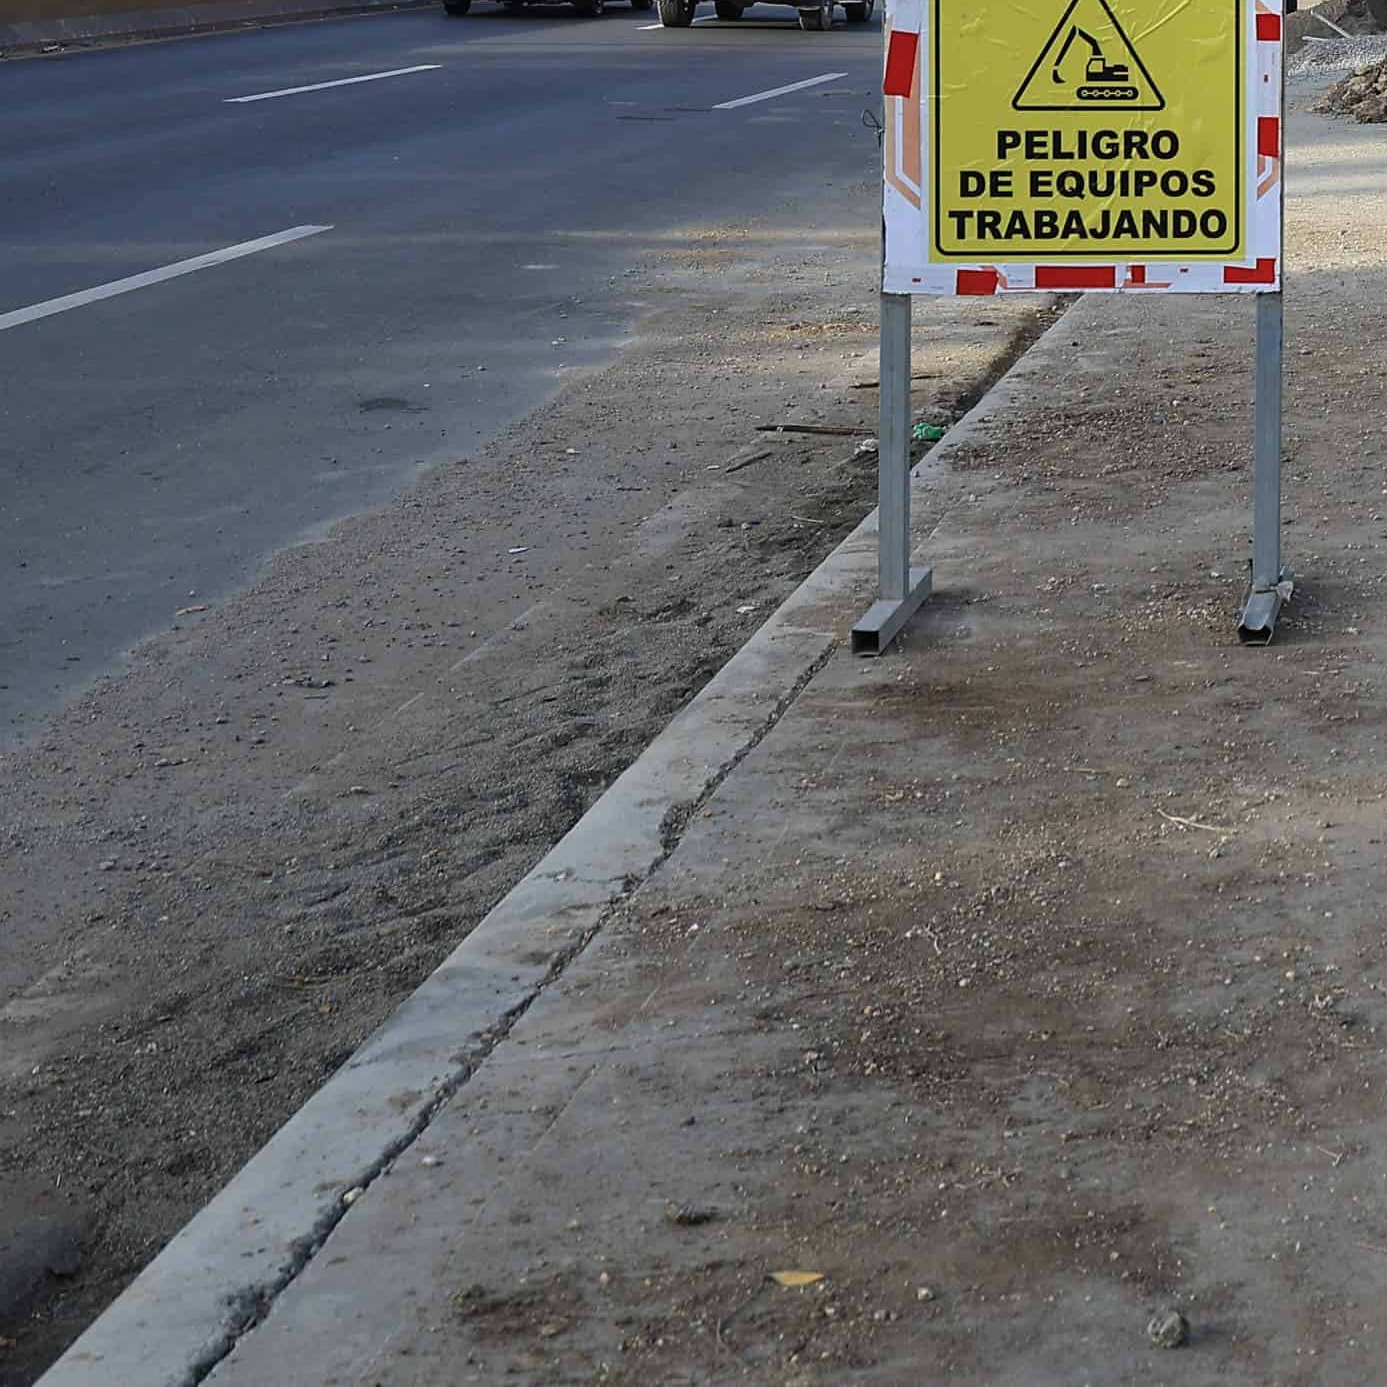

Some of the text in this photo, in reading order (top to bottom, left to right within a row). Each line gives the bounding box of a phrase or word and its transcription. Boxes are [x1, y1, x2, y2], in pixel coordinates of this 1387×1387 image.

[997, 130, 1180, 160] PELIGRO
[959, 169, 1217, 200] DE EQUIPOS
[948, 209, 1228, 241] TRABAJANDO
